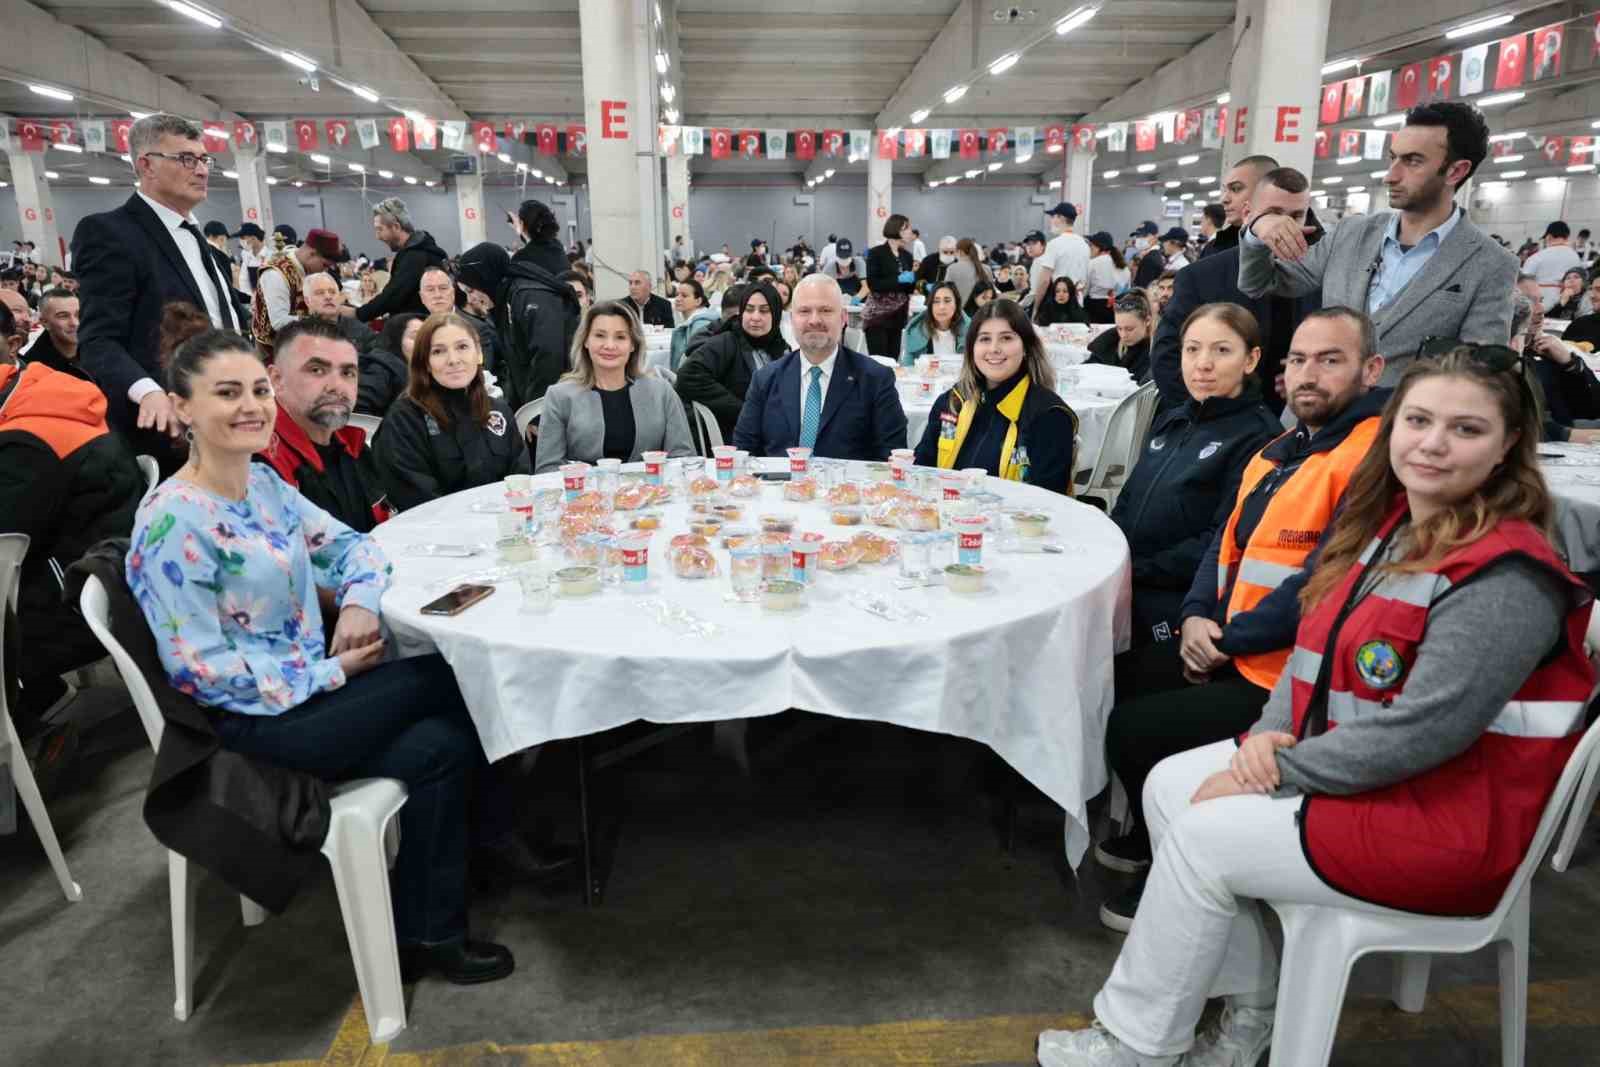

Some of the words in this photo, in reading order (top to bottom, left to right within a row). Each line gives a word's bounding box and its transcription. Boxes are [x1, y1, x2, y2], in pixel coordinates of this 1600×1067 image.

[601, 100, 628, 138] E
[1234, 106, 1248, 144] E
[1275, 106, 1301, 142] E
[25, 208, 37, 221] G
[247, 208, 257, 219] G
[465, 208, 477, 220] G
[672, 207, 683, 217] G
[876, 208, 886, 218] G
